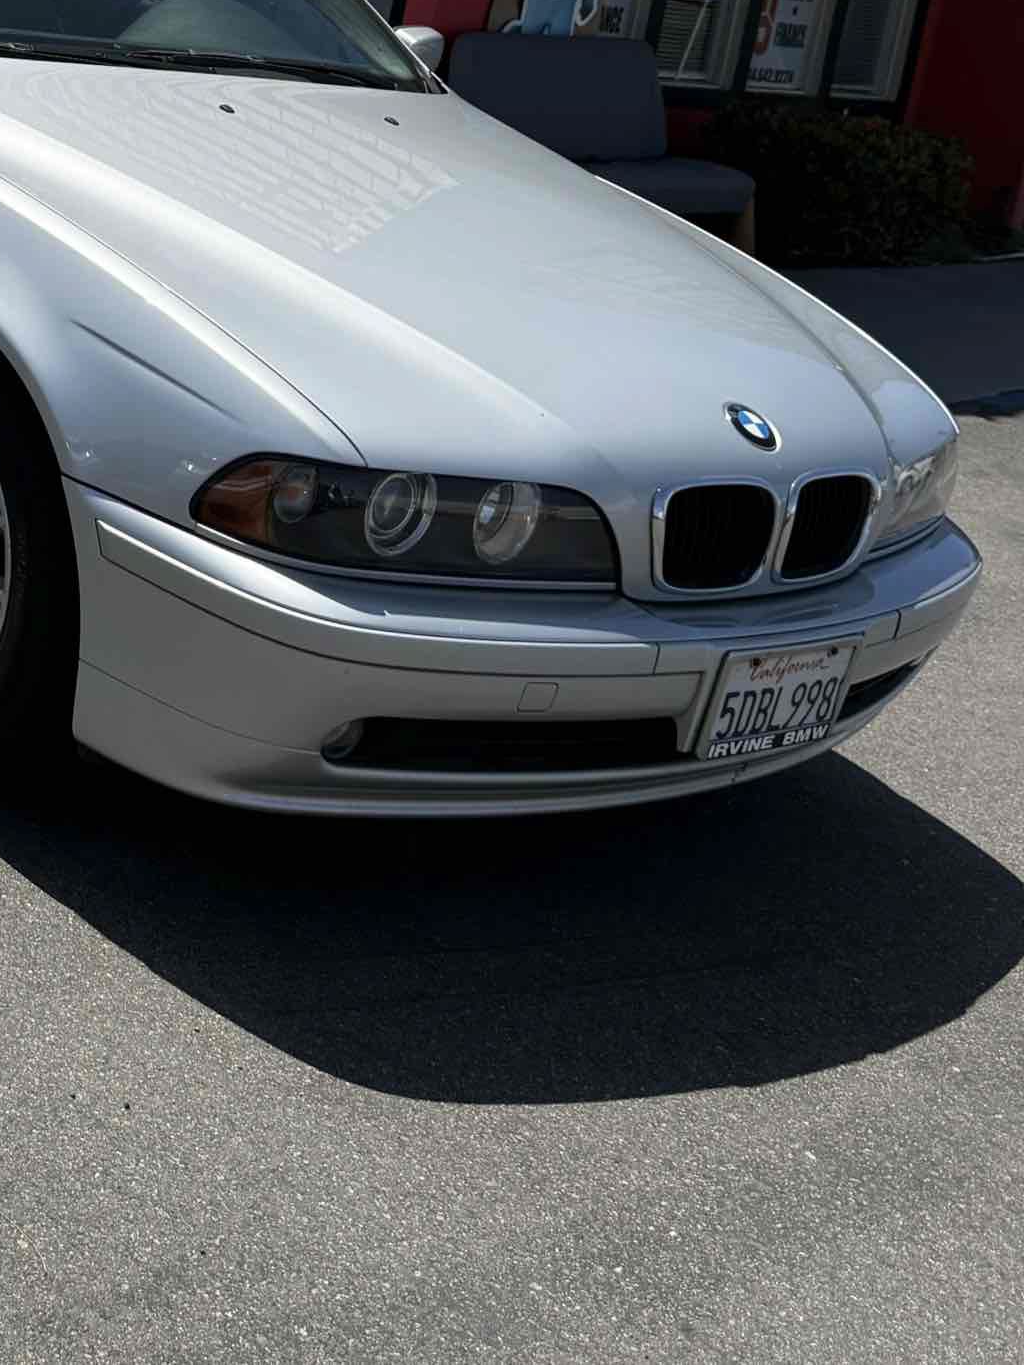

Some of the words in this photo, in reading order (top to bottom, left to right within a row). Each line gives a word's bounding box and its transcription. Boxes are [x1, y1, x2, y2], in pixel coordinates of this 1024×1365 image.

[714, 676, 840, 741] 5DBL998
[708, 735, 775, 759] IRVINE
[782, 724, 829, 746] BMW
